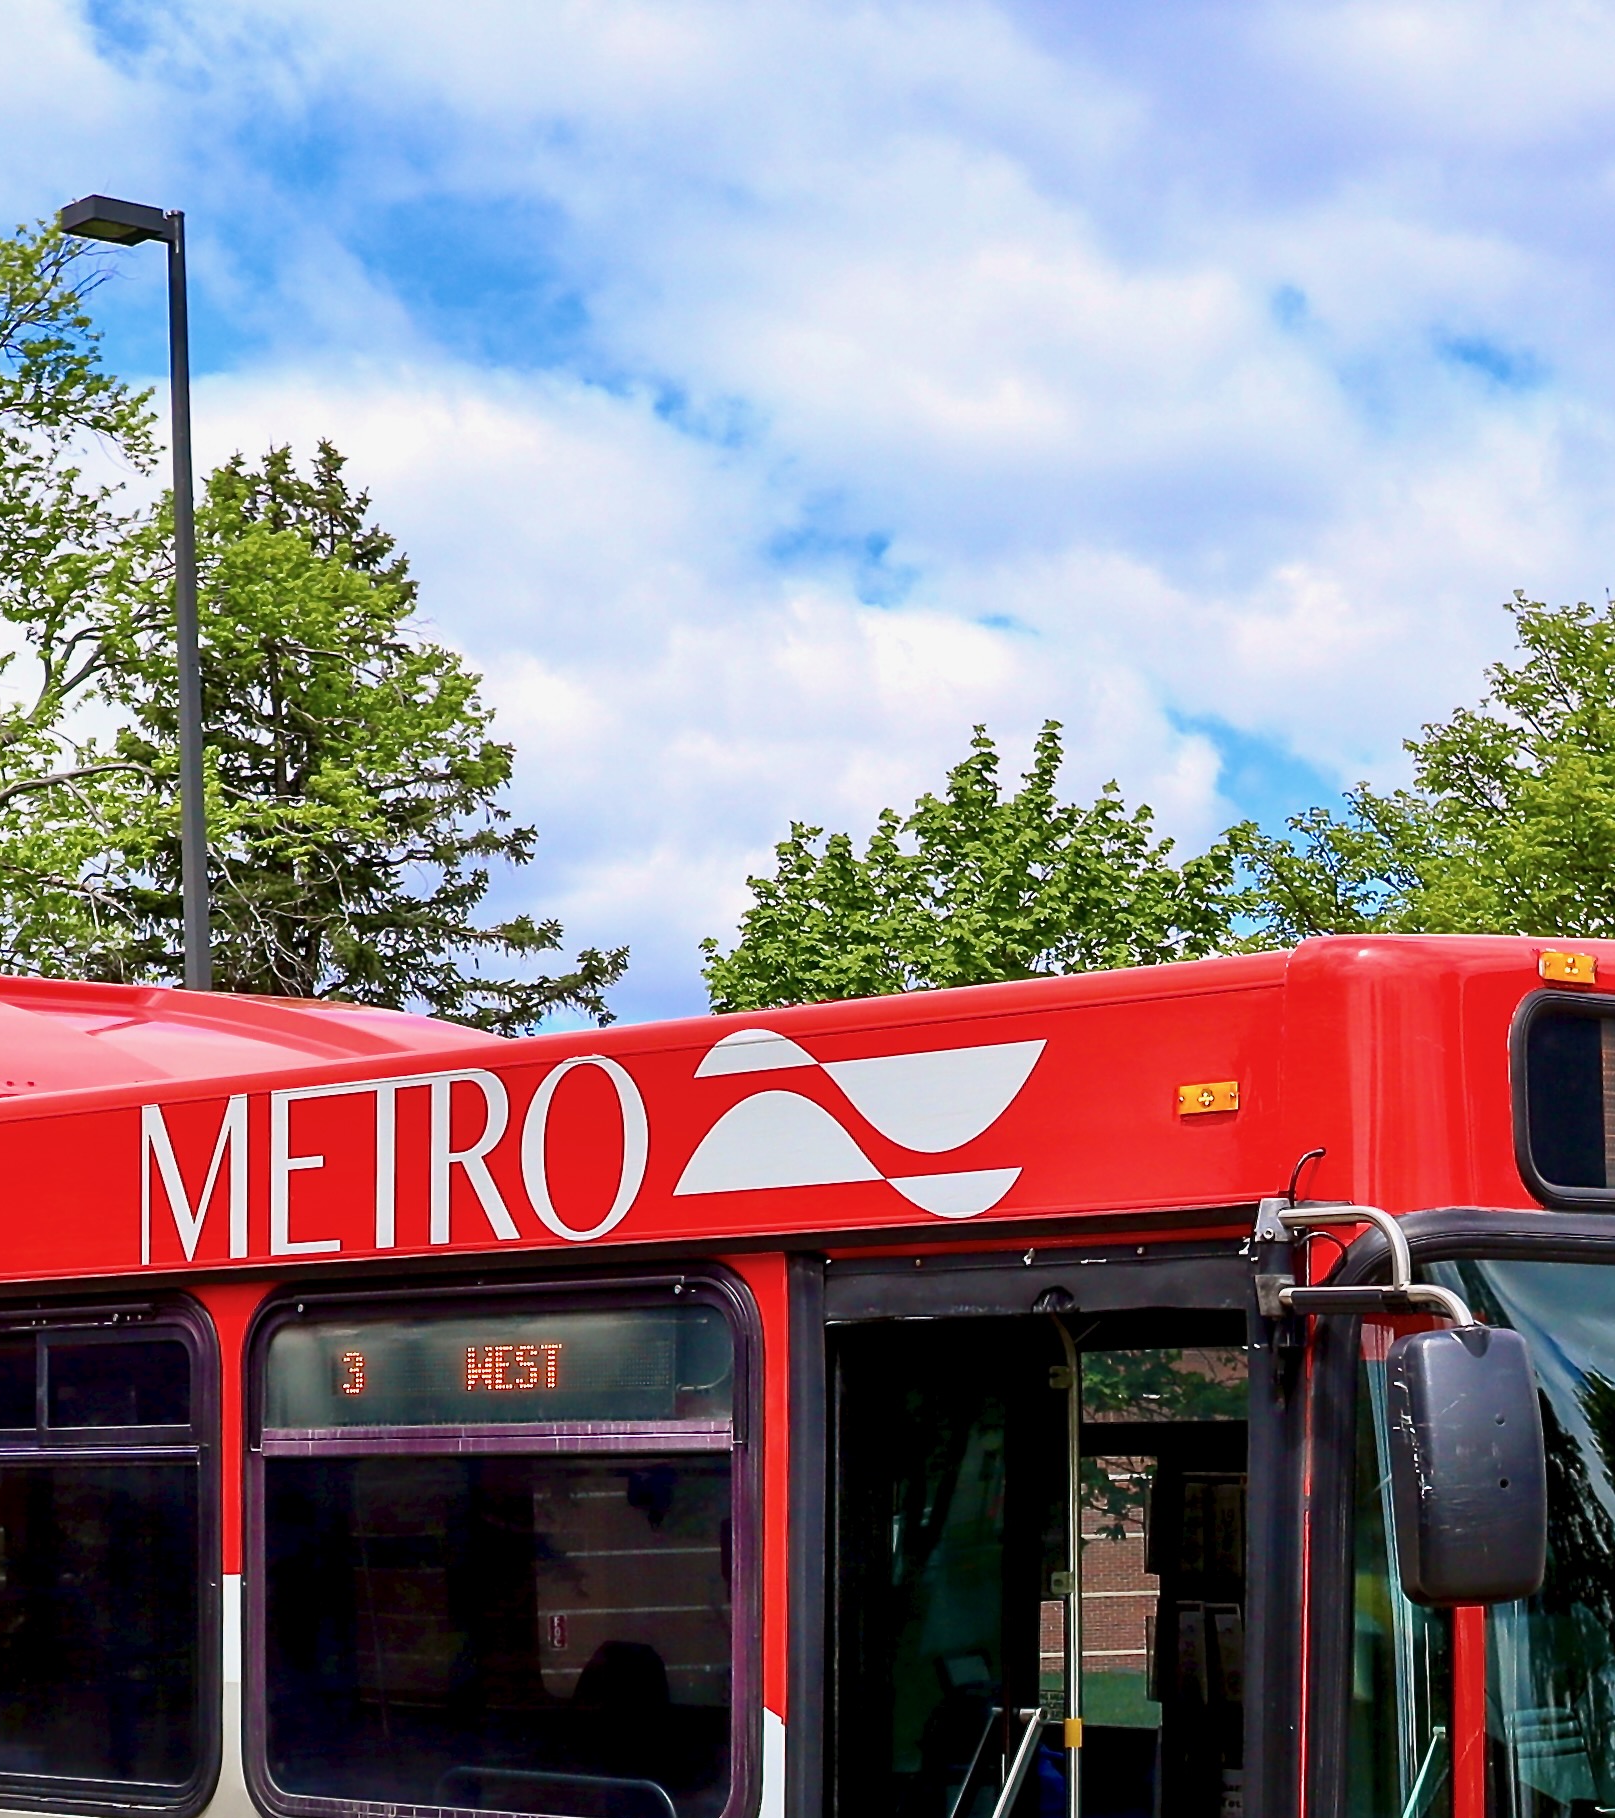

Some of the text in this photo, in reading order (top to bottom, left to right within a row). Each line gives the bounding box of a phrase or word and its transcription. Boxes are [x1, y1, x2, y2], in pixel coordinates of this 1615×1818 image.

[141, 1054, 649, 1266] METRO
[341, 1343, 564, 1395] 3 WEST
